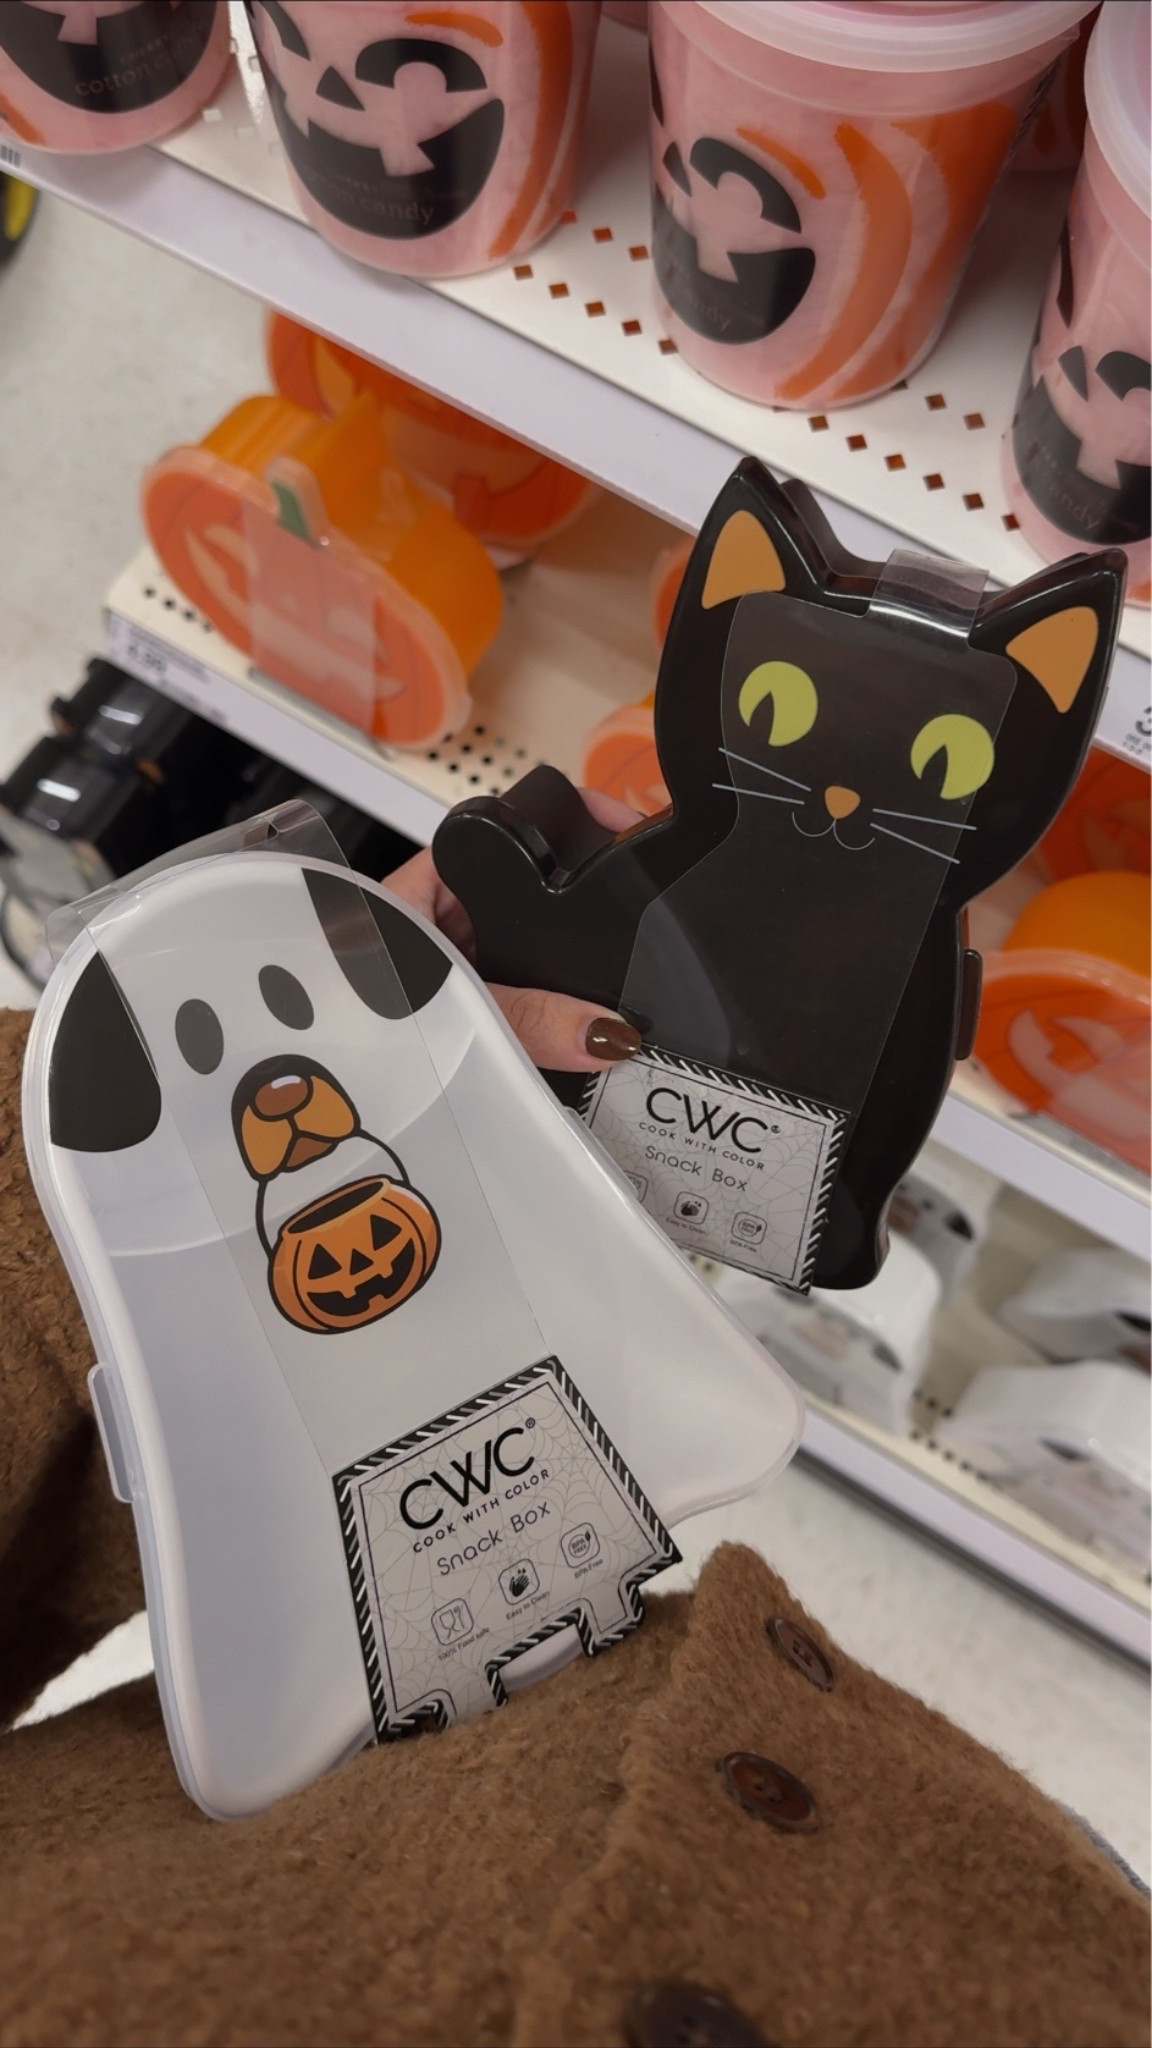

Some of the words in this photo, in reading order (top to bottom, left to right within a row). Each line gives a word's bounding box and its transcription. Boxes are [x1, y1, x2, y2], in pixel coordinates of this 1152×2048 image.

[638, 1121, 676, 1140] COOK
[684, 1137, 716, 1154] WITH
[722, 1150, 765, 1171] COLOR
[645, 1145, 702, 1176] Snack
[712, 1168, 748, 1192] Box
[413, 1523, 456, 1553] COOK
[463, 1498, 500, 1524] WITH
[504, 1469, 549, 1500] COLOR
[437, 1530, 503, 1576] Snack
[510, 1501, 551, 1533] Box
